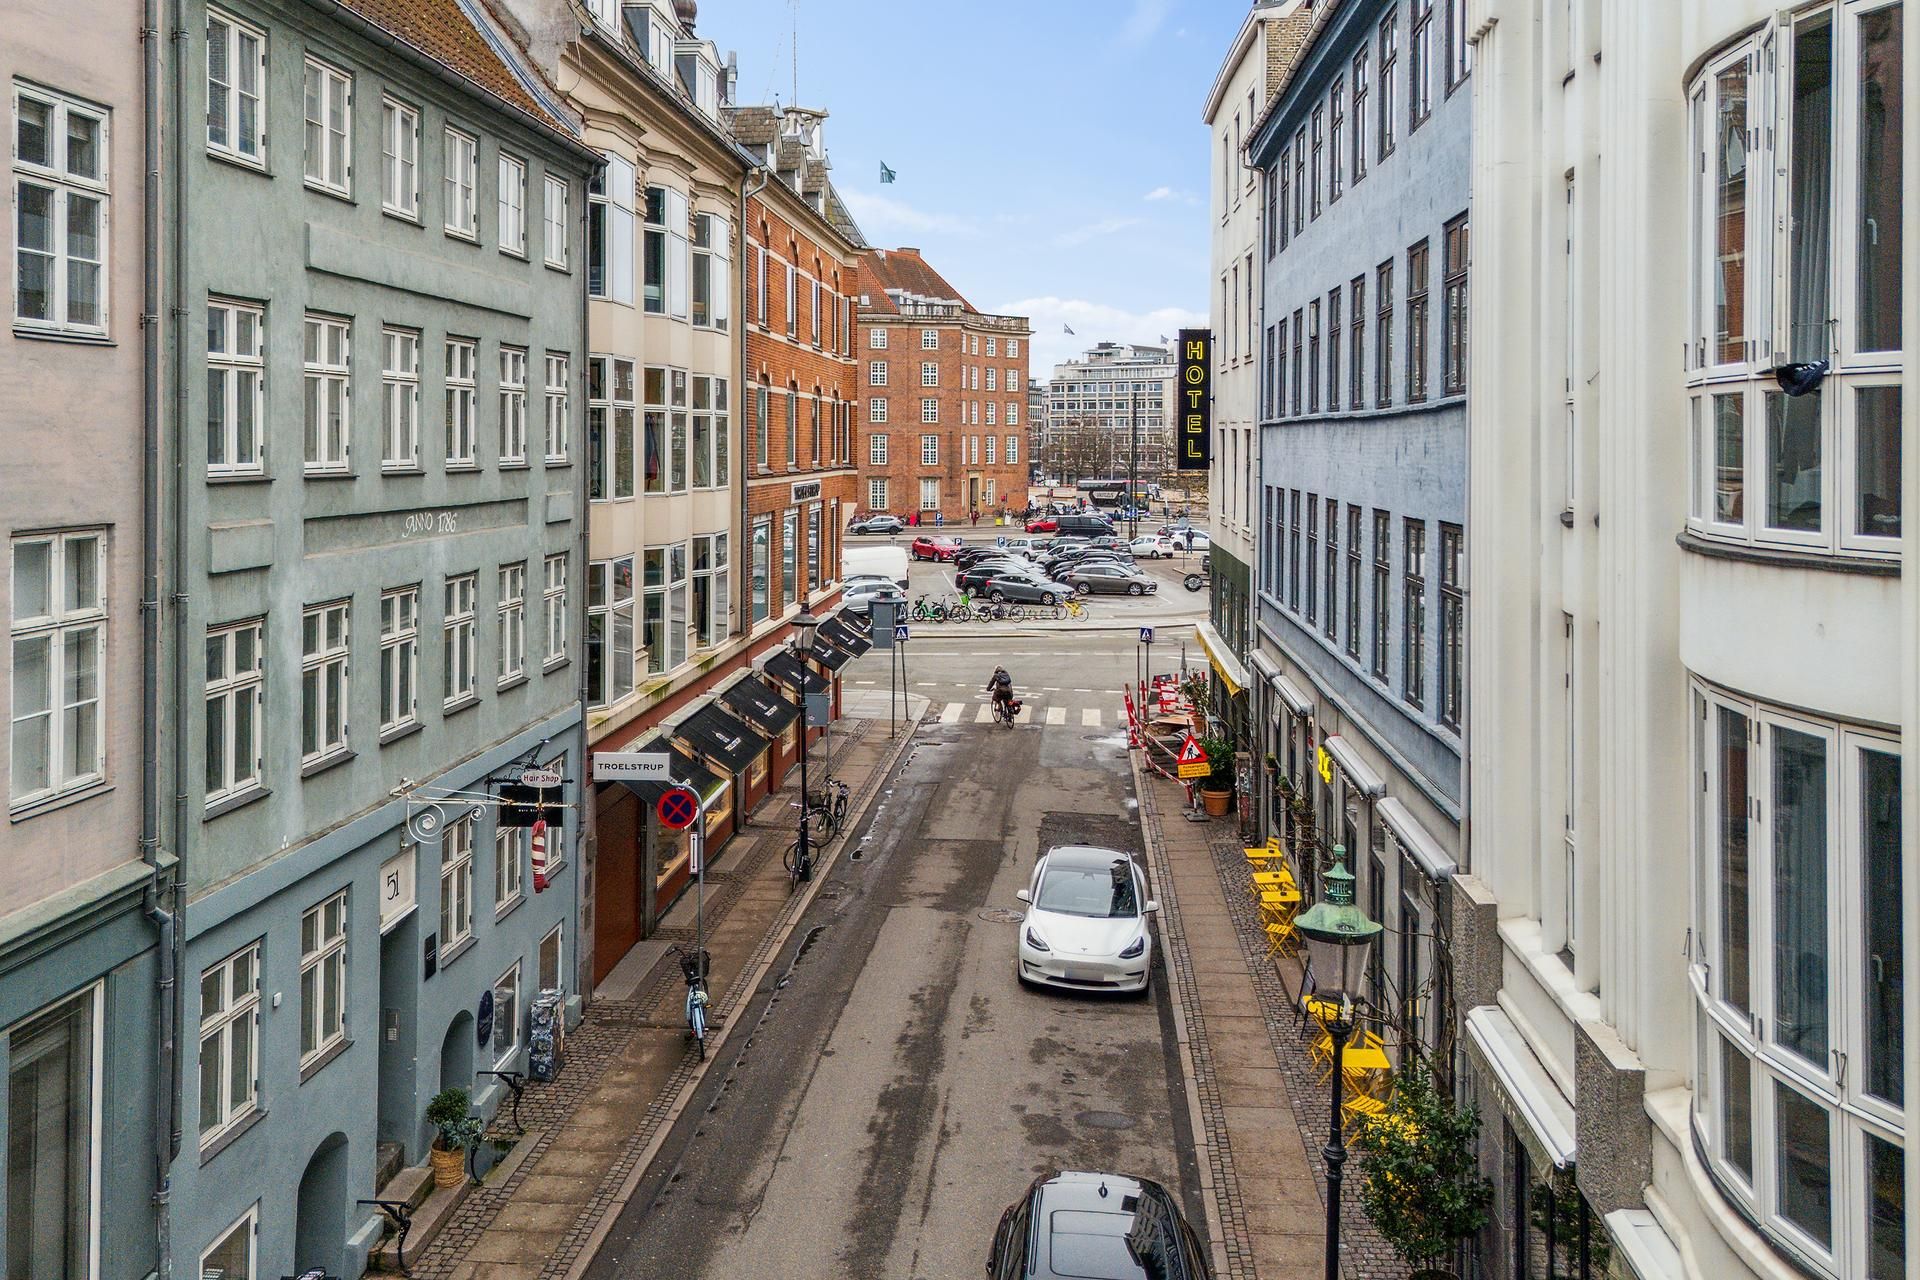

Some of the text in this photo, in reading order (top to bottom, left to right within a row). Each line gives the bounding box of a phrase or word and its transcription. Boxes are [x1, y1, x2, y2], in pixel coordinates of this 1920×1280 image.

[1185, 341, 1204, 458] HOTEL
[402, 512, 433, 538] ANNO
[523, 774, 559, 784] Hair Shop
[597, 763, 664, 771] TROELSTRUP
[387, 869, 400, 901] 51
